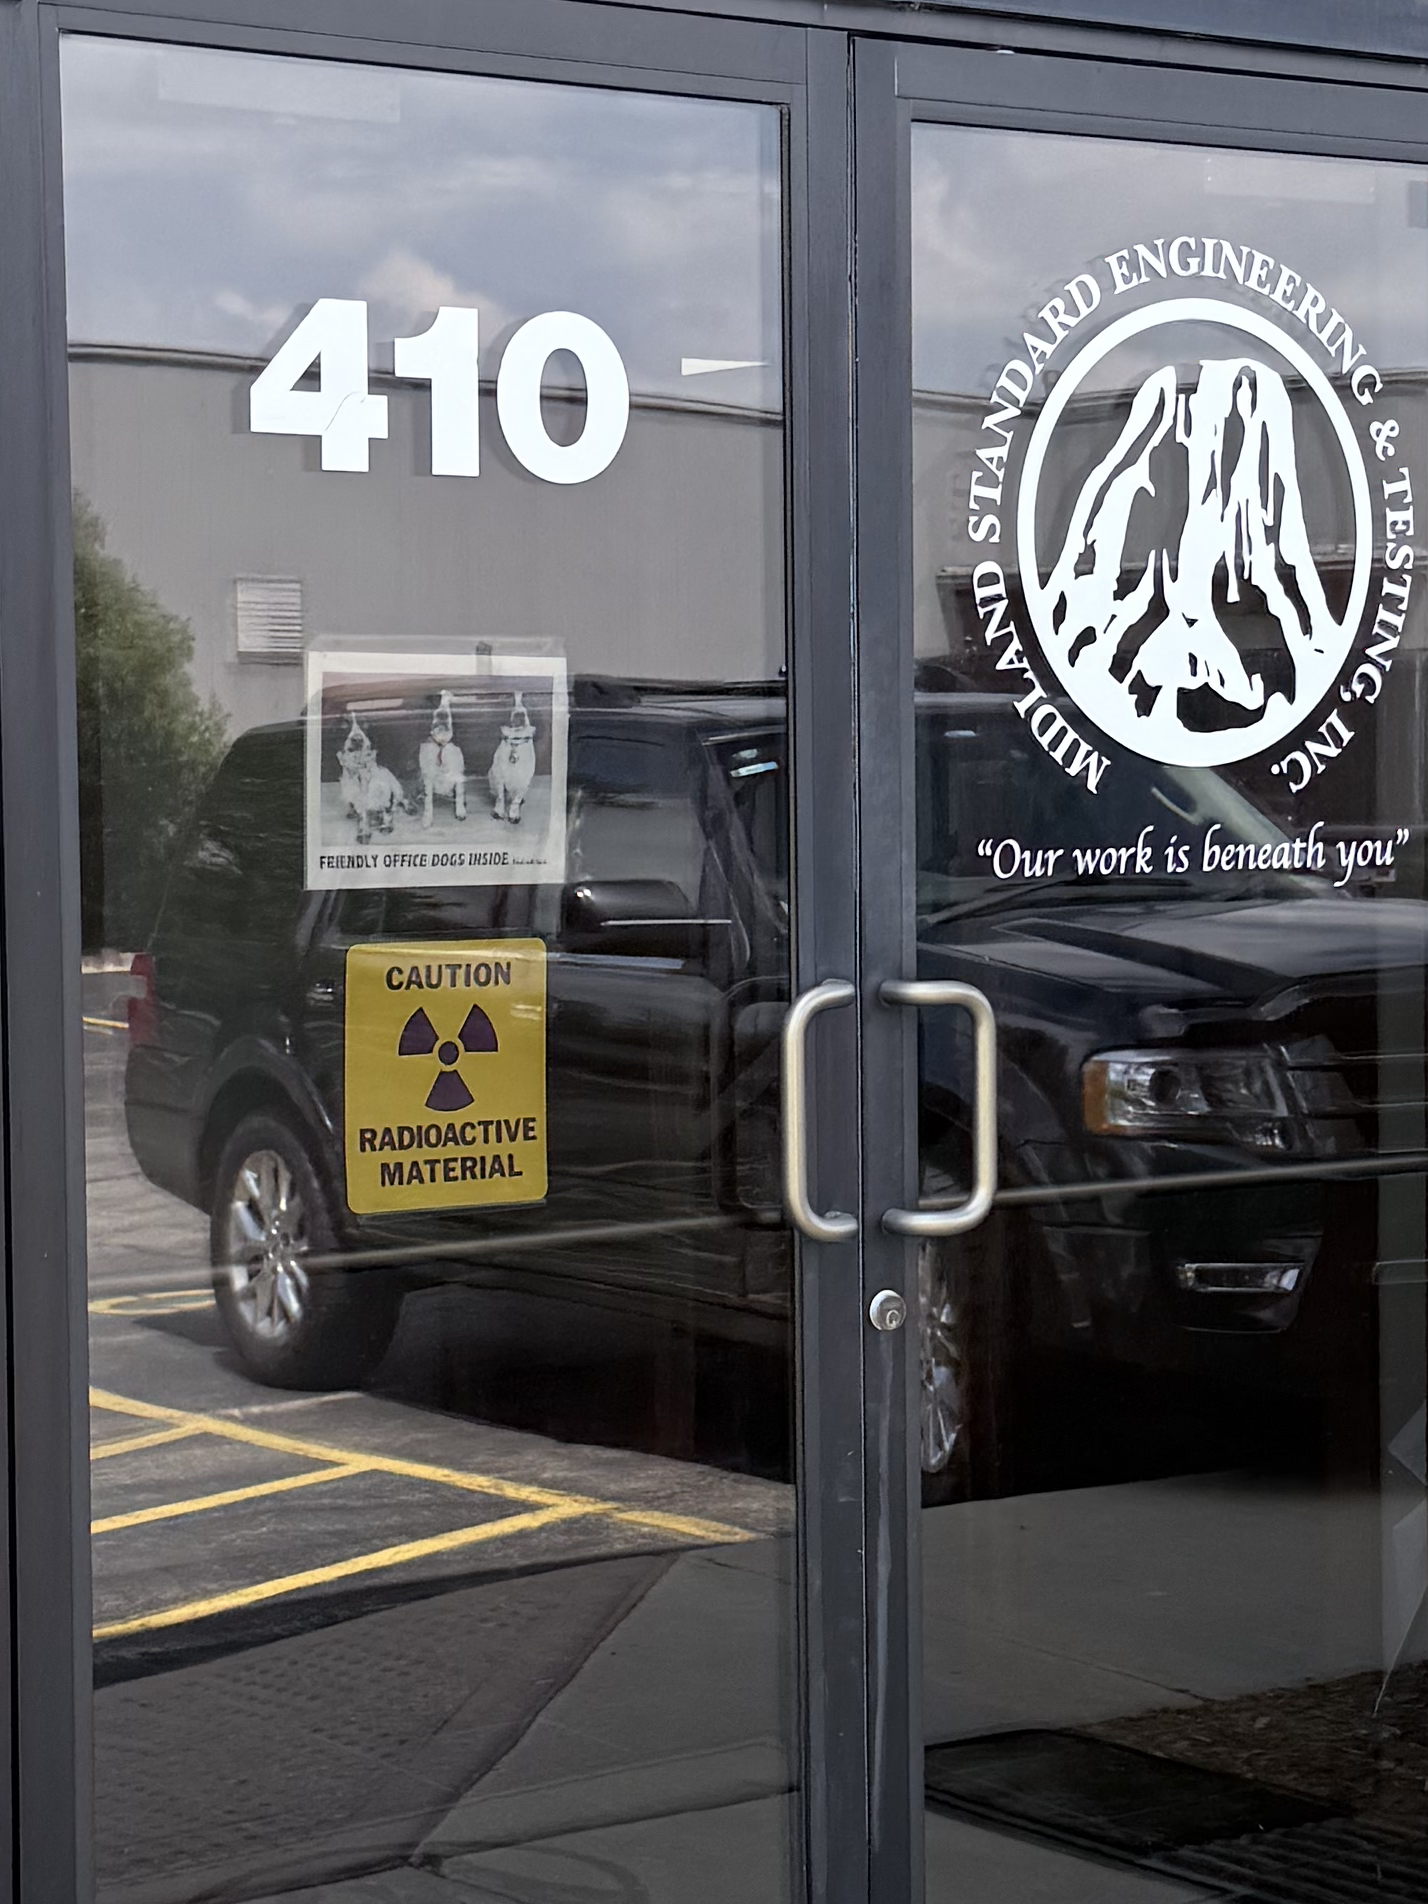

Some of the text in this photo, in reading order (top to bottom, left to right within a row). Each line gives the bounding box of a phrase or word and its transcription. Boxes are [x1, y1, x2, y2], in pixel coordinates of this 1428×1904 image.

[251, 298, 629, 484] 410
[968, 235, 1415, 794] MIDLAND STANDARD ENGINEERING & TESTING, INC.
[383, 853, 427, 868] OFFICE
[431, 852, 465, 867] DOGS
[468, 852, 509, 866] INSIDE
[1073, 826, 1156, 875] work
[1164, 832, 1191, 874] is
[1202, 822, 1326, 872] beneath
[385, 962, 512, 991] CAUTION
[359, 1117, 538, 1153] RADIOACTIVE
[380, 1154, 523, 1187] MATERIAL
